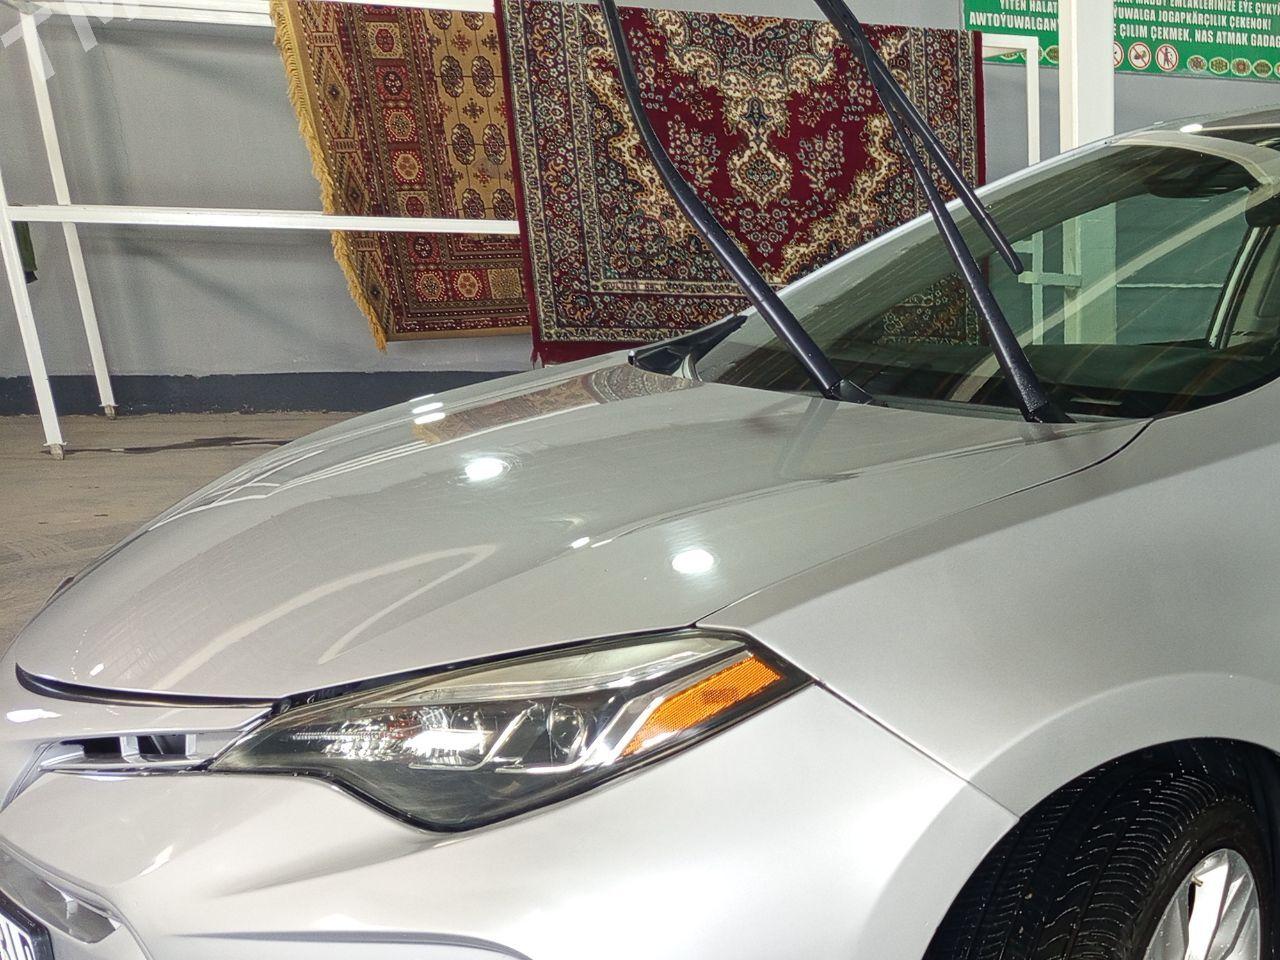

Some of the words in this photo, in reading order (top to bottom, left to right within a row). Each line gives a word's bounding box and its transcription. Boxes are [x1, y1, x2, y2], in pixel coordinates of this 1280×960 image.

[969, 11, 1059, 32] AWTOÝUWALGAN
[1119, 23, 1148, 39] ÇILIM
[1195, 29, 1214, 44] NAS
[1216, 31, 1248, 46] ATMAK
